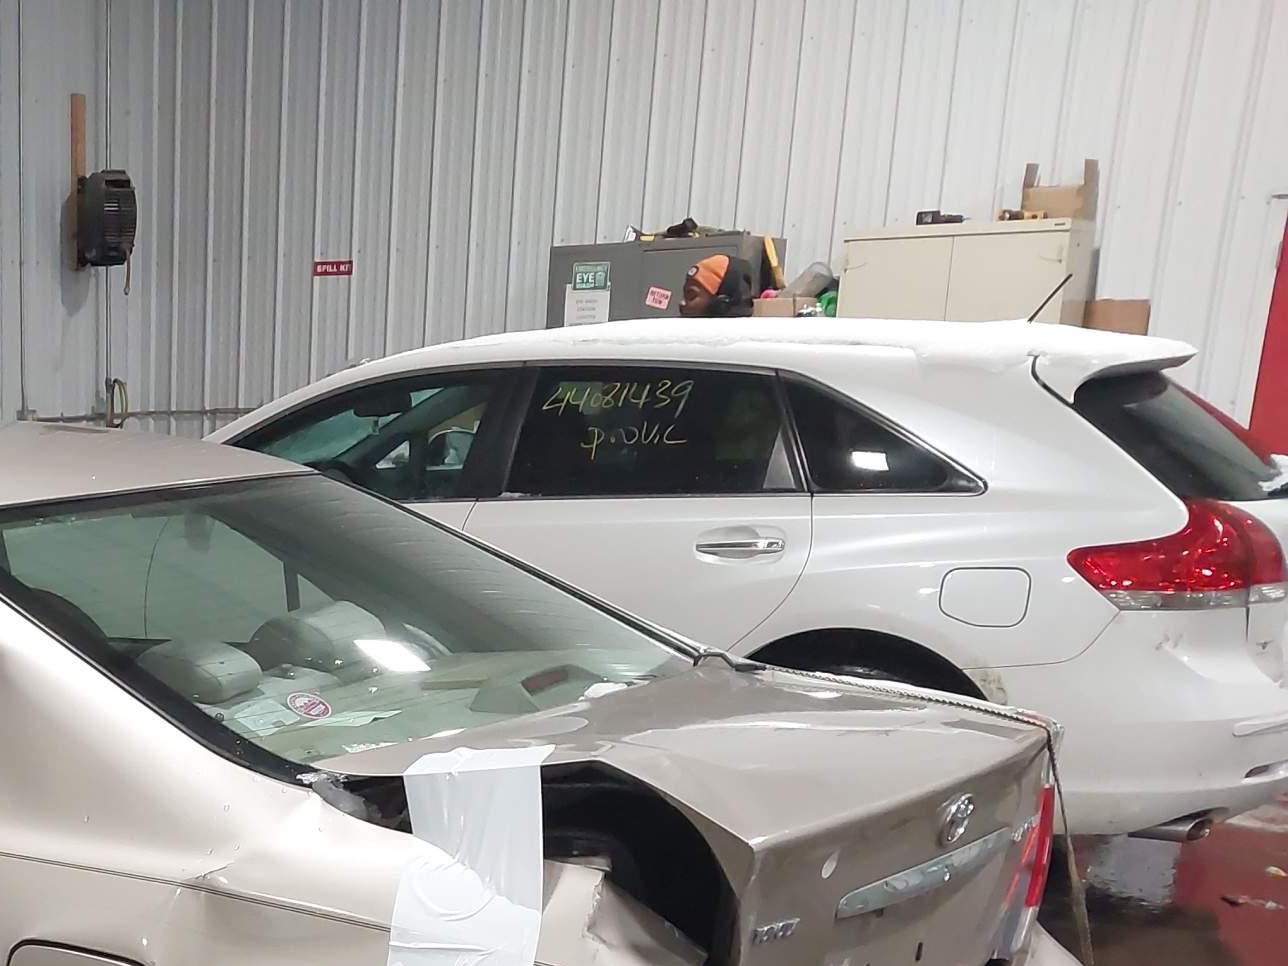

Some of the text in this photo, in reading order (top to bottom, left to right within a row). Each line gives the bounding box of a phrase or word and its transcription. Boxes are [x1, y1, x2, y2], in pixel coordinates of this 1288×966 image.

[316, 263, 337, 272] SPILL
[576, 272, 594, 283] EYE
[542, 379, 695, 418] 44081439
